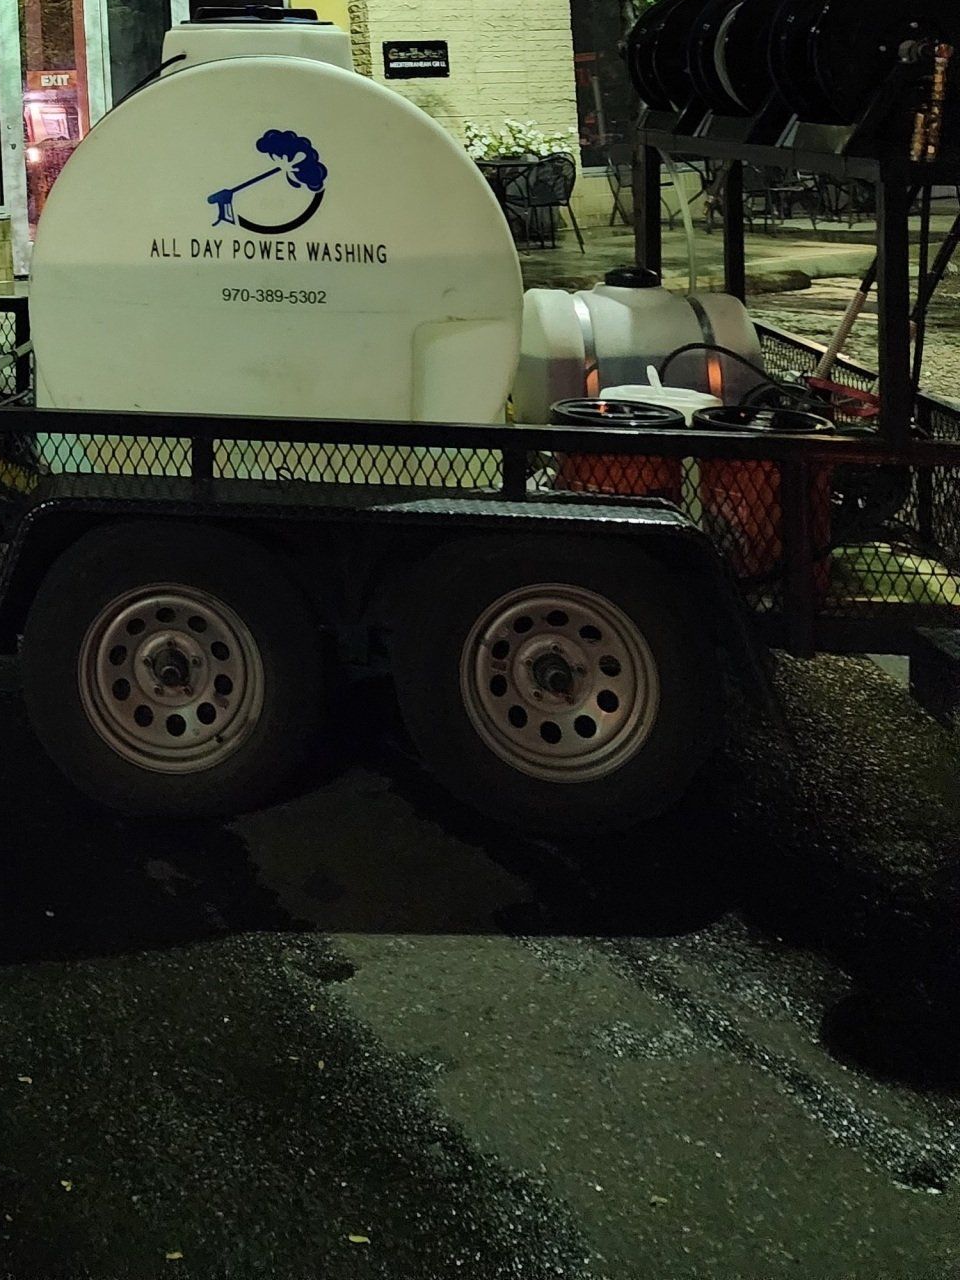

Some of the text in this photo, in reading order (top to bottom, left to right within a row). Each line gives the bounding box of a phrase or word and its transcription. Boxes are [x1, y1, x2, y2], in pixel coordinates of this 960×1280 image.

[40, 74, 69, 87] EXIT
[150, 238, 387, 264] ALL DAY POWER WASHING
[222, 288, 327, 304] 970-389-5302
